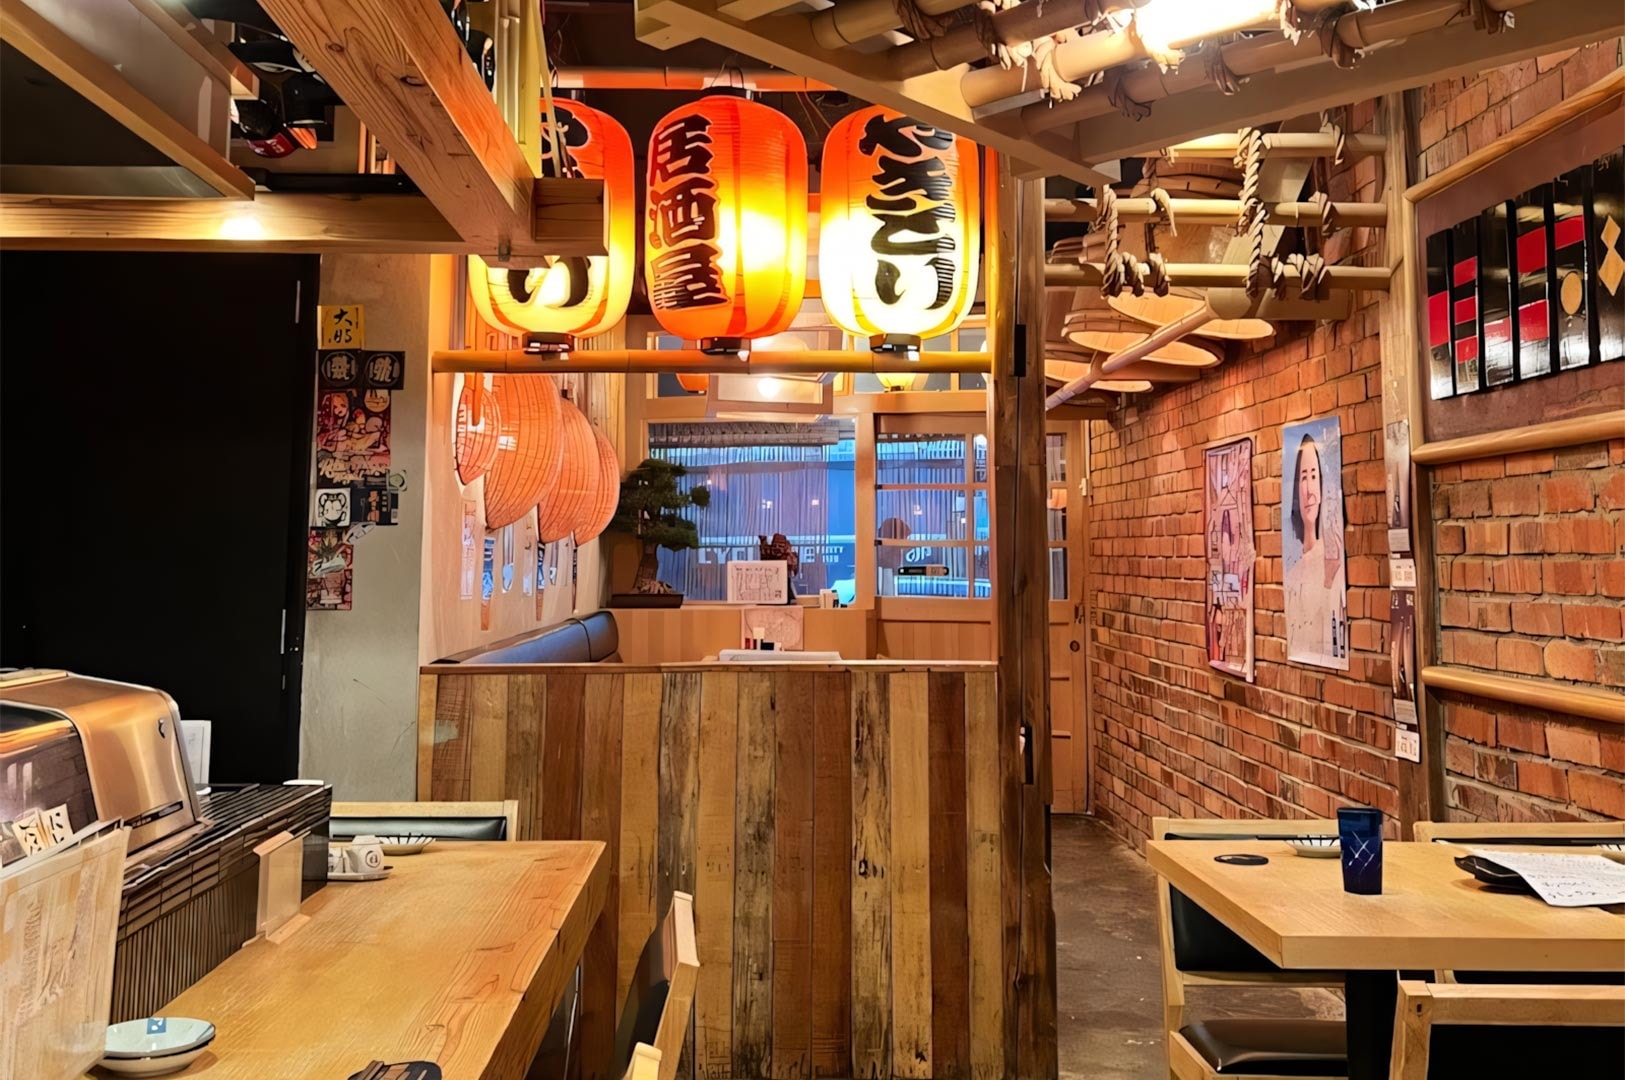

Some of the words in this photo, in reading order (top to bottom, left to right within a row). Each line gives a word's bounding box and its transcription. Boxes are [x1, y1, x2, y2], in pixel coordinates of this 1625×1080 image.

[649, 113, 731, 310] 居酒屋
[858, 113, 956, 311] やきとり
